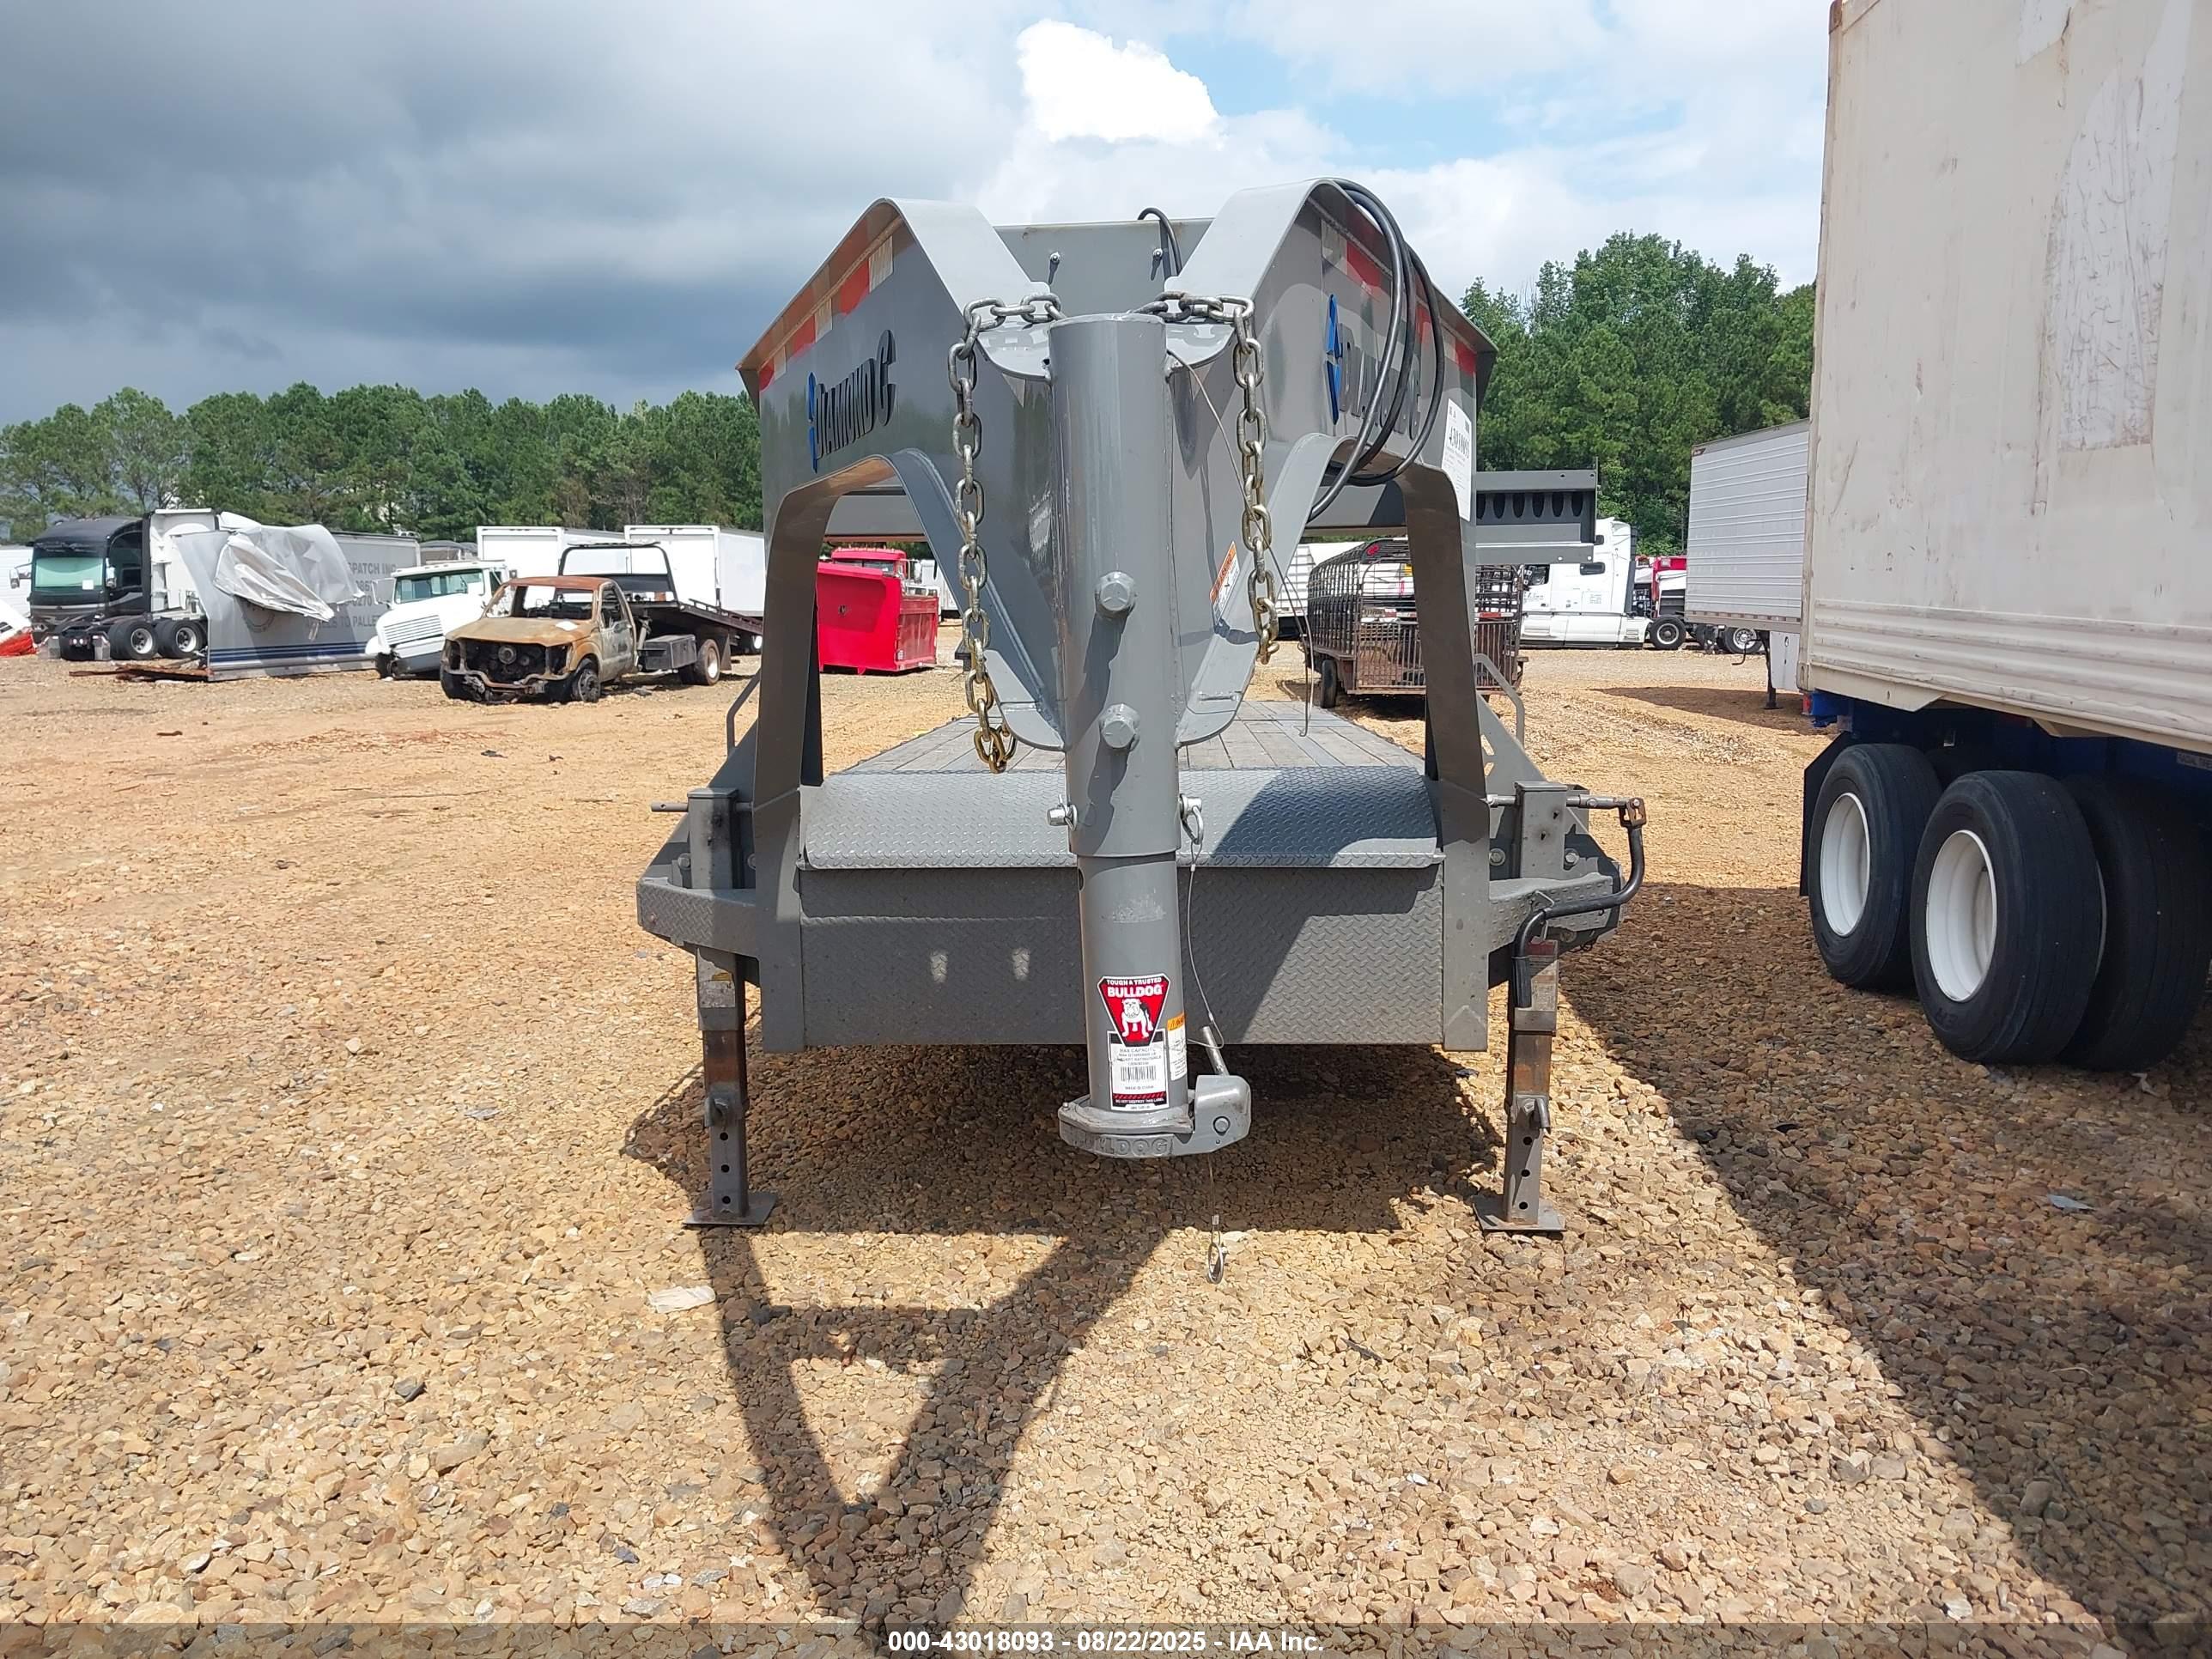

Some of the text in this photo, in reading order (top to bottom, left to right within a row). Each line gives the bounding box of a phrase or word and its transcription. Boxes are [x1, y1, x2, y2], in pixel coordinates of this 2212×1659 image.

[816, 329, 896, 460] DIAMOND C
[1133, 977, 1162, 986] TRUSTED
[1107, 984, 1163, 998] BULLDOG
